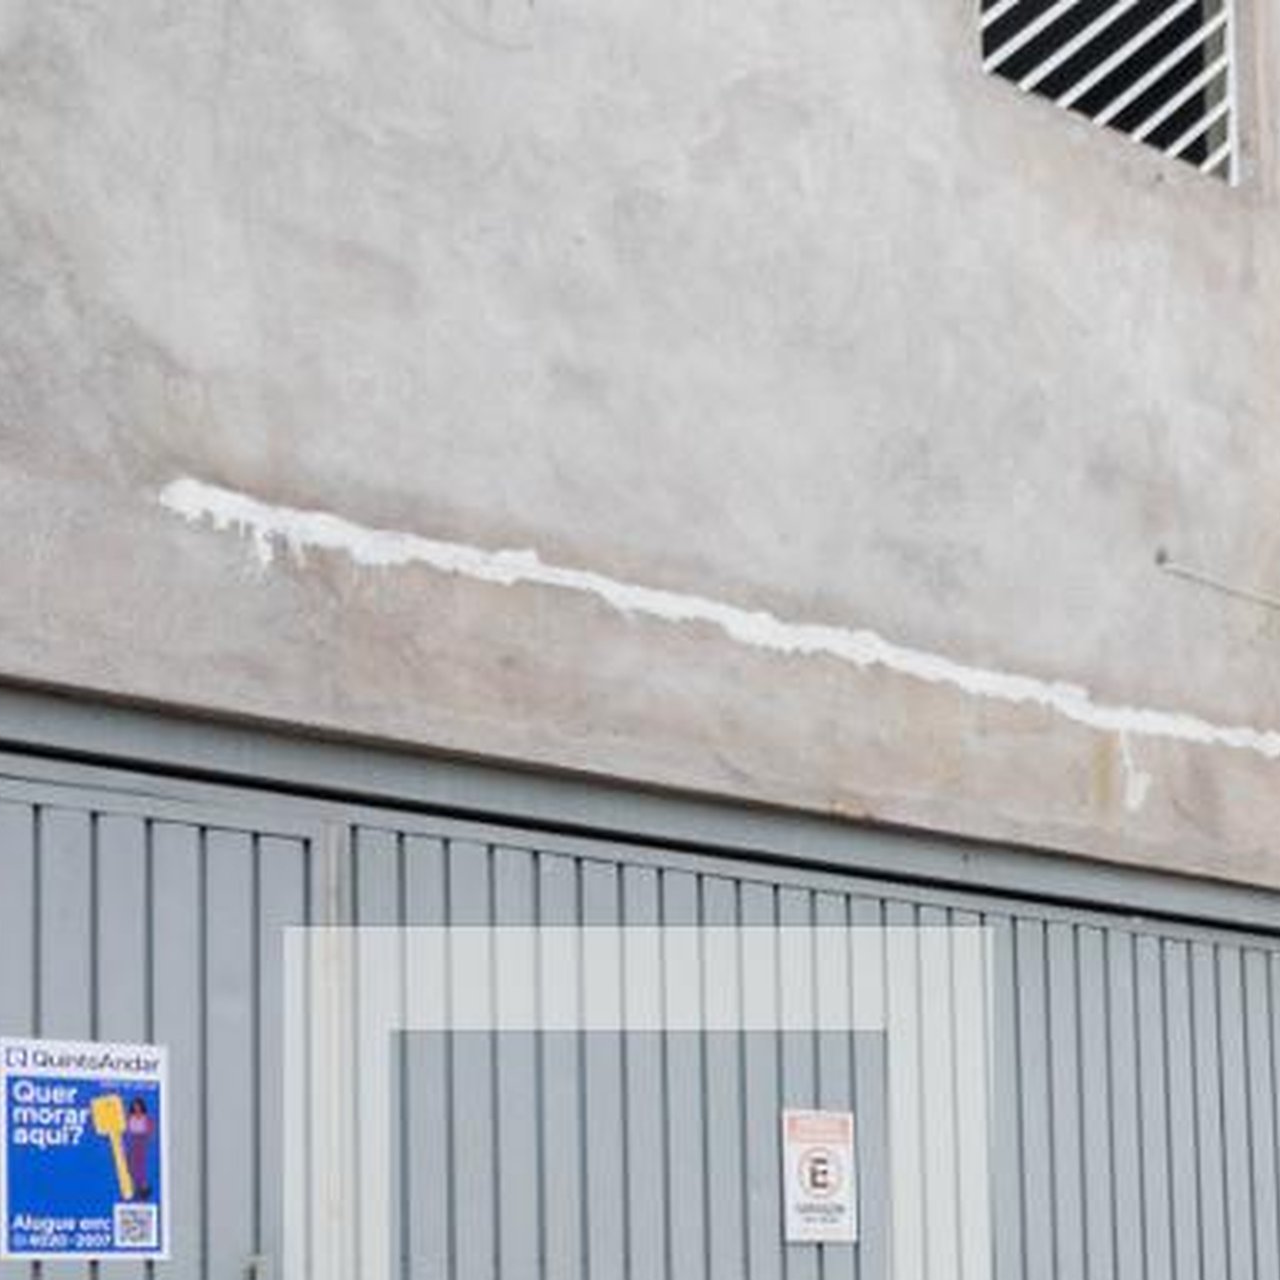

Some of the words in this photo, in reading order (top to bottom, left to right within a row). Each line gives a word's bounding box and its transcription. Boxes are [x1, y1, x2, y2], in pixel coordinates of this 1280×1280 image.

[32, 1048, 161, 1071] QuintoAndar
[12, 1079, 77, 1105] Quer
[13, 1106, 89, 1125] morar
[13, 1125, 84, 1149] aqui?
[810, 1157, 828, 1189] E
[12, 1211, 75, 1233] Alugue
